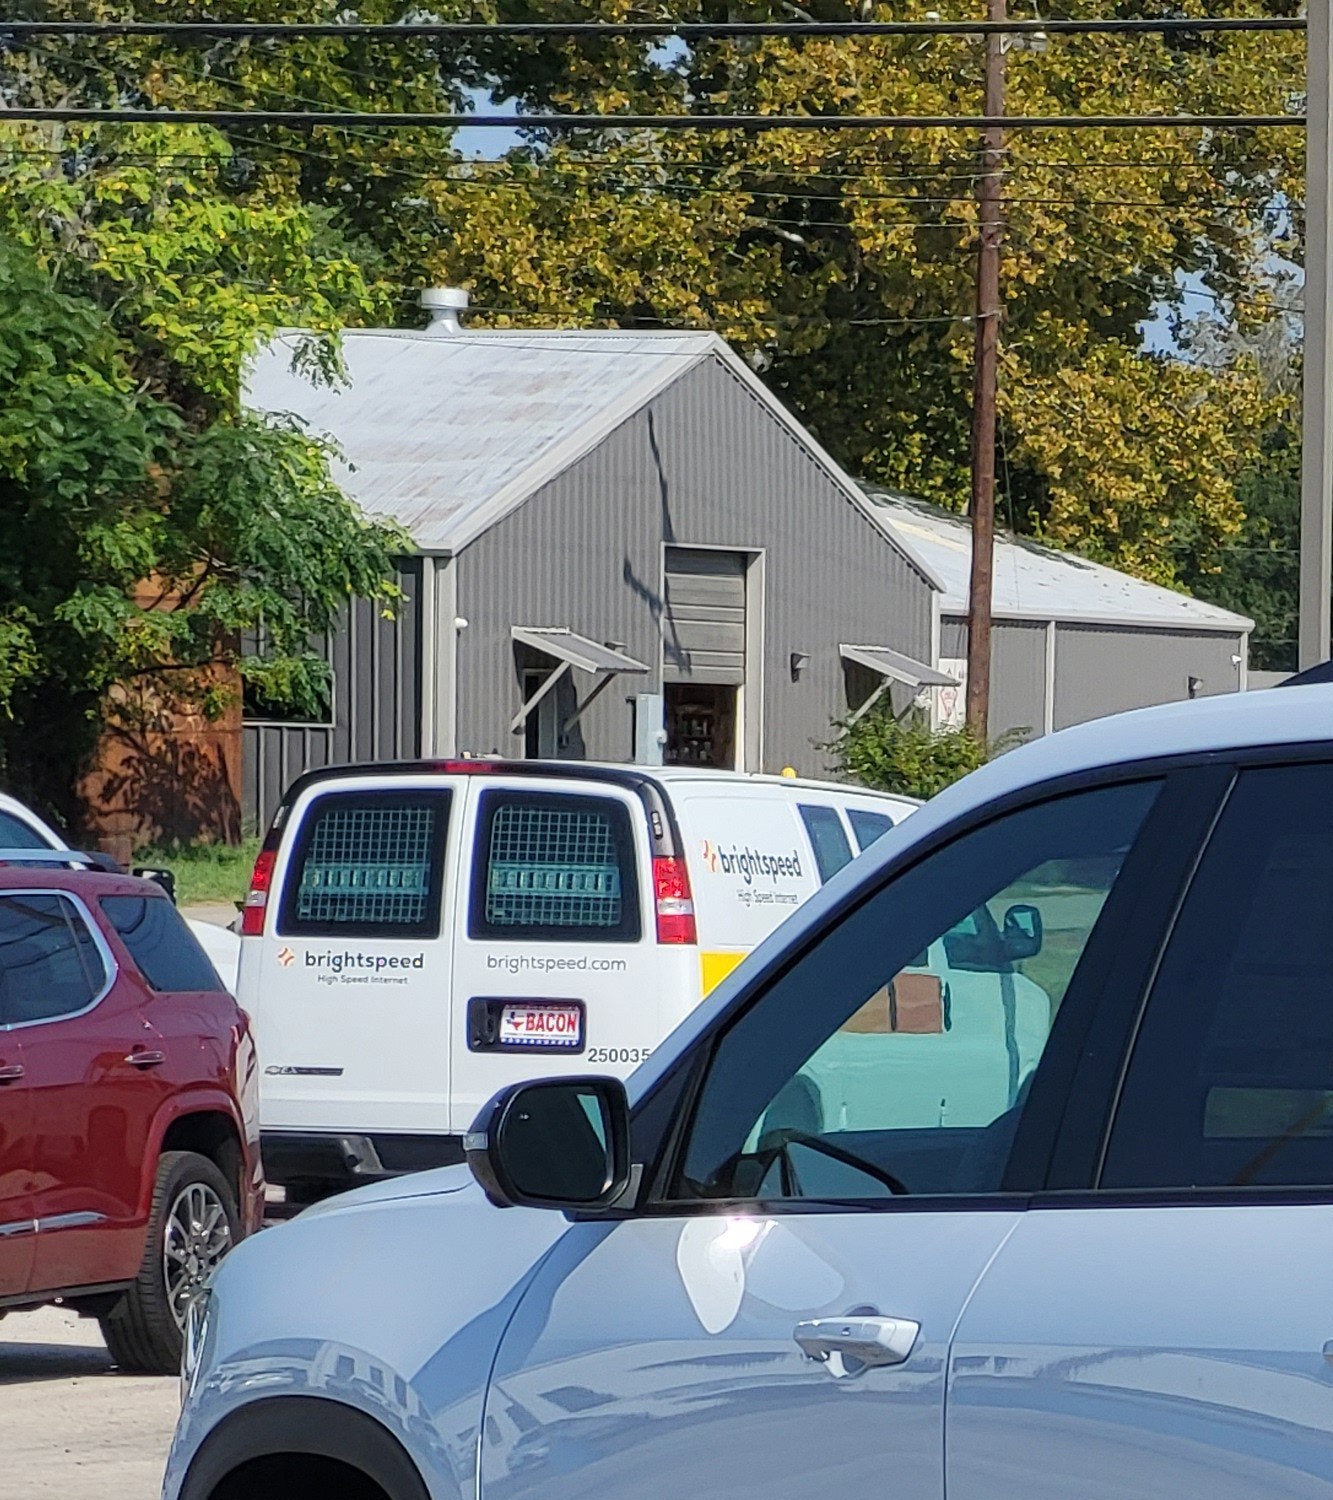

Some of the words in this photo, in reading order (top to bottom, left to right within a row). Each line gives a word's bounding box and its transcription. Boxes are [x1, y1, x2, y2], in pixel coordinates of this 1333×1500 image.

[718, 844, 802, 885] brightspeed
[305, 950, 424, 973] brightspeed
[487, 954, 626, 974] brightspeed.com
[317, 974, 338, 986] High
[340, 975, 368, 985] Speed
[371, 976, 408, 985] Internet
[525, 1012, 579, 1033] BACON
[587, 1048, 651, 1063] 250035
